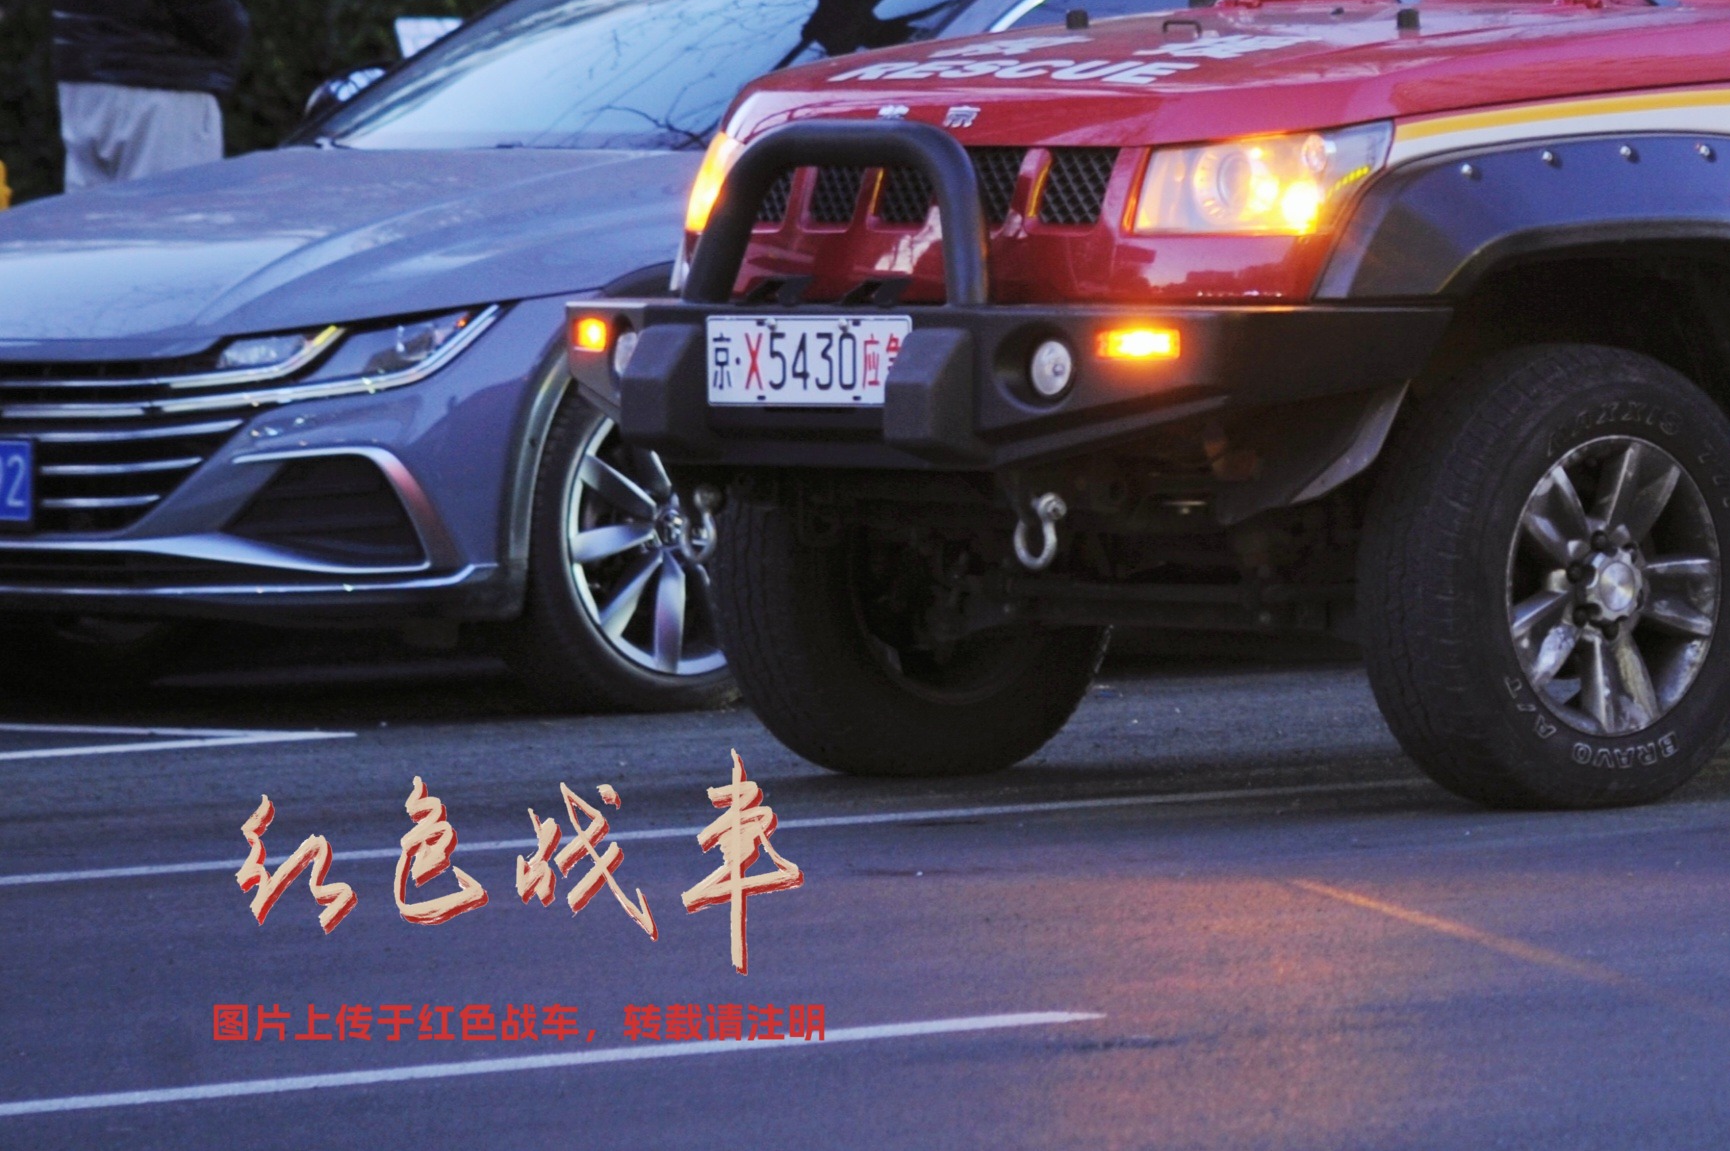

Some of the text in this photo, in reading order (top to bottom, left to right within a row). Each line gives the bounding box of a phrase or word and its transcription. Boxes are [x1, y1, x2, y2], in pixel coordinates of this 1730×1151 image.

[828, 59, 1201, 85] RESCUE
[1504, 675, 1681, 770] BRAVO A/T
